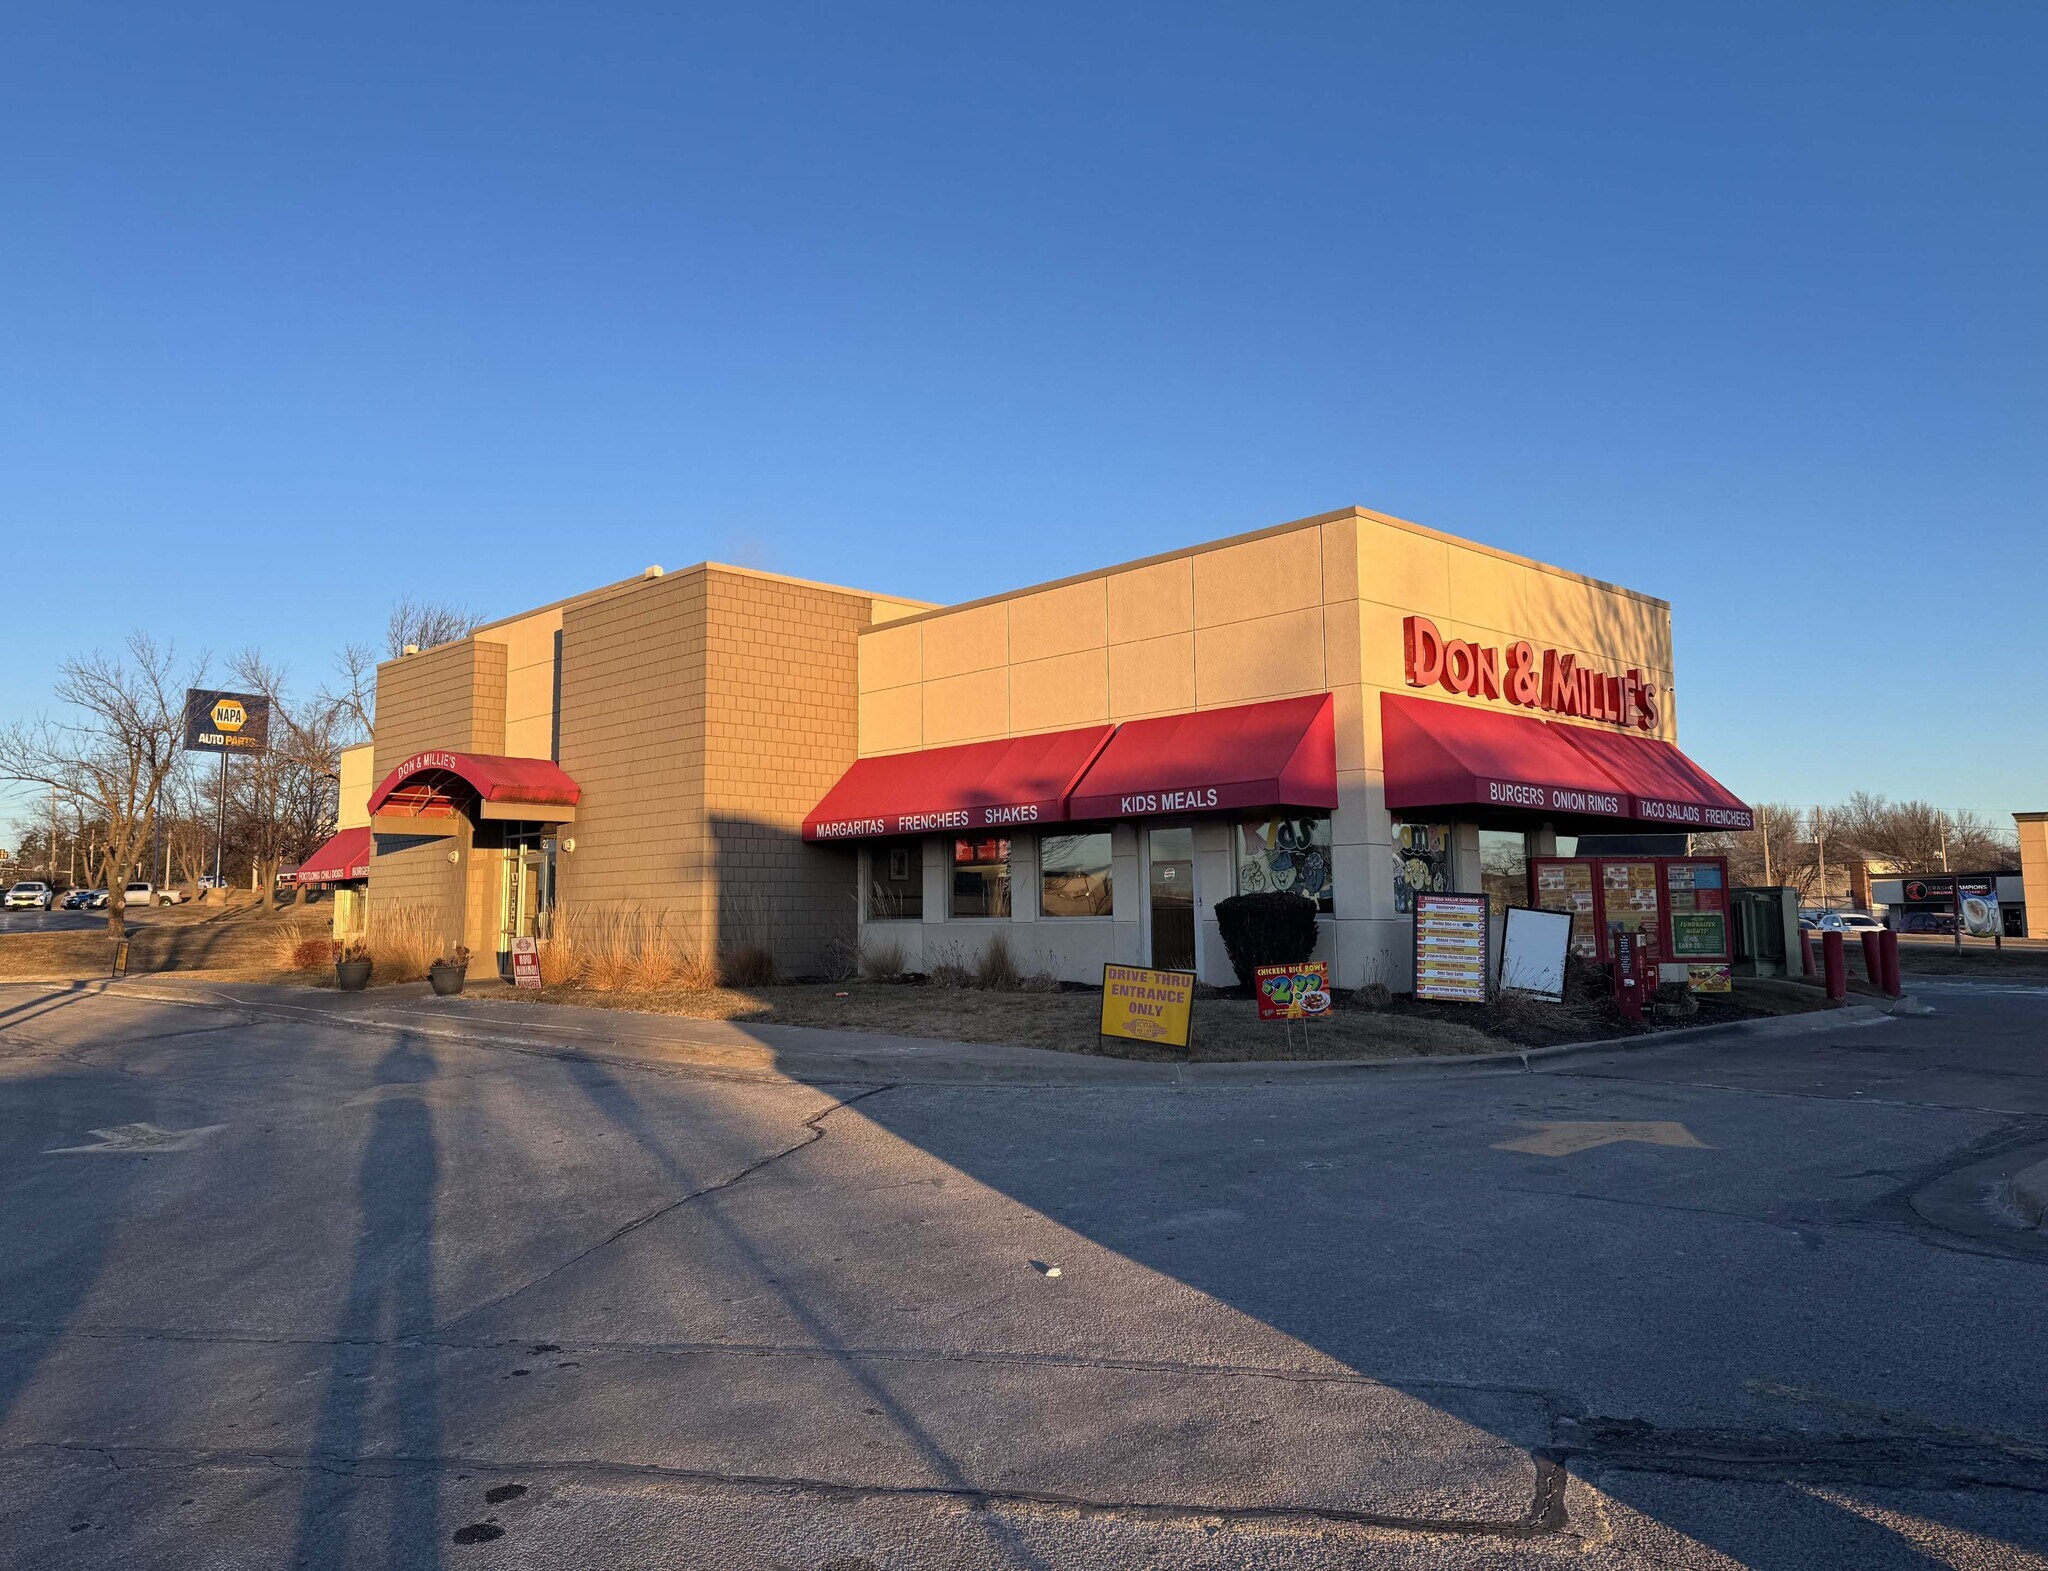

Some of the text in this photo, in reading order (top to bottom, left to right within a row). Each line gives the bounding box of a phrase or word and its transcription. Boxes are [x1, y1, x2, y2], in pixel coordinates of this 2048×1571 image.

[1403, 615, 1659, 731] DON & MILLIE'S
[216, 708, 241, 723] NAPA
[198, 733, 256, 747] AUTO PARTS
[398, 753, 456, 779] DON & MILLIE'S
[1121, 788, 1218, 813] KIDS MEALS
[1489, 782, 1618, 813] BURGERS ONION RINGS
[816, 805, 1038, 838] MARGARITAS FRENCHEES SHAKES
[1640, 800, 1751, 827] TACO SALADS FRENCHEES
[298, 868, 344, 881] FOOTLONG CHILI DOGS
[1257, 963, 1325, 976] CHICKEN RICE BOWL
[1111, 984, 1185, 1003] ENTRANCE
[1262, 973, 1324, 1005] $2.99
[1128, 1001, 1164, 1017] ONLY
